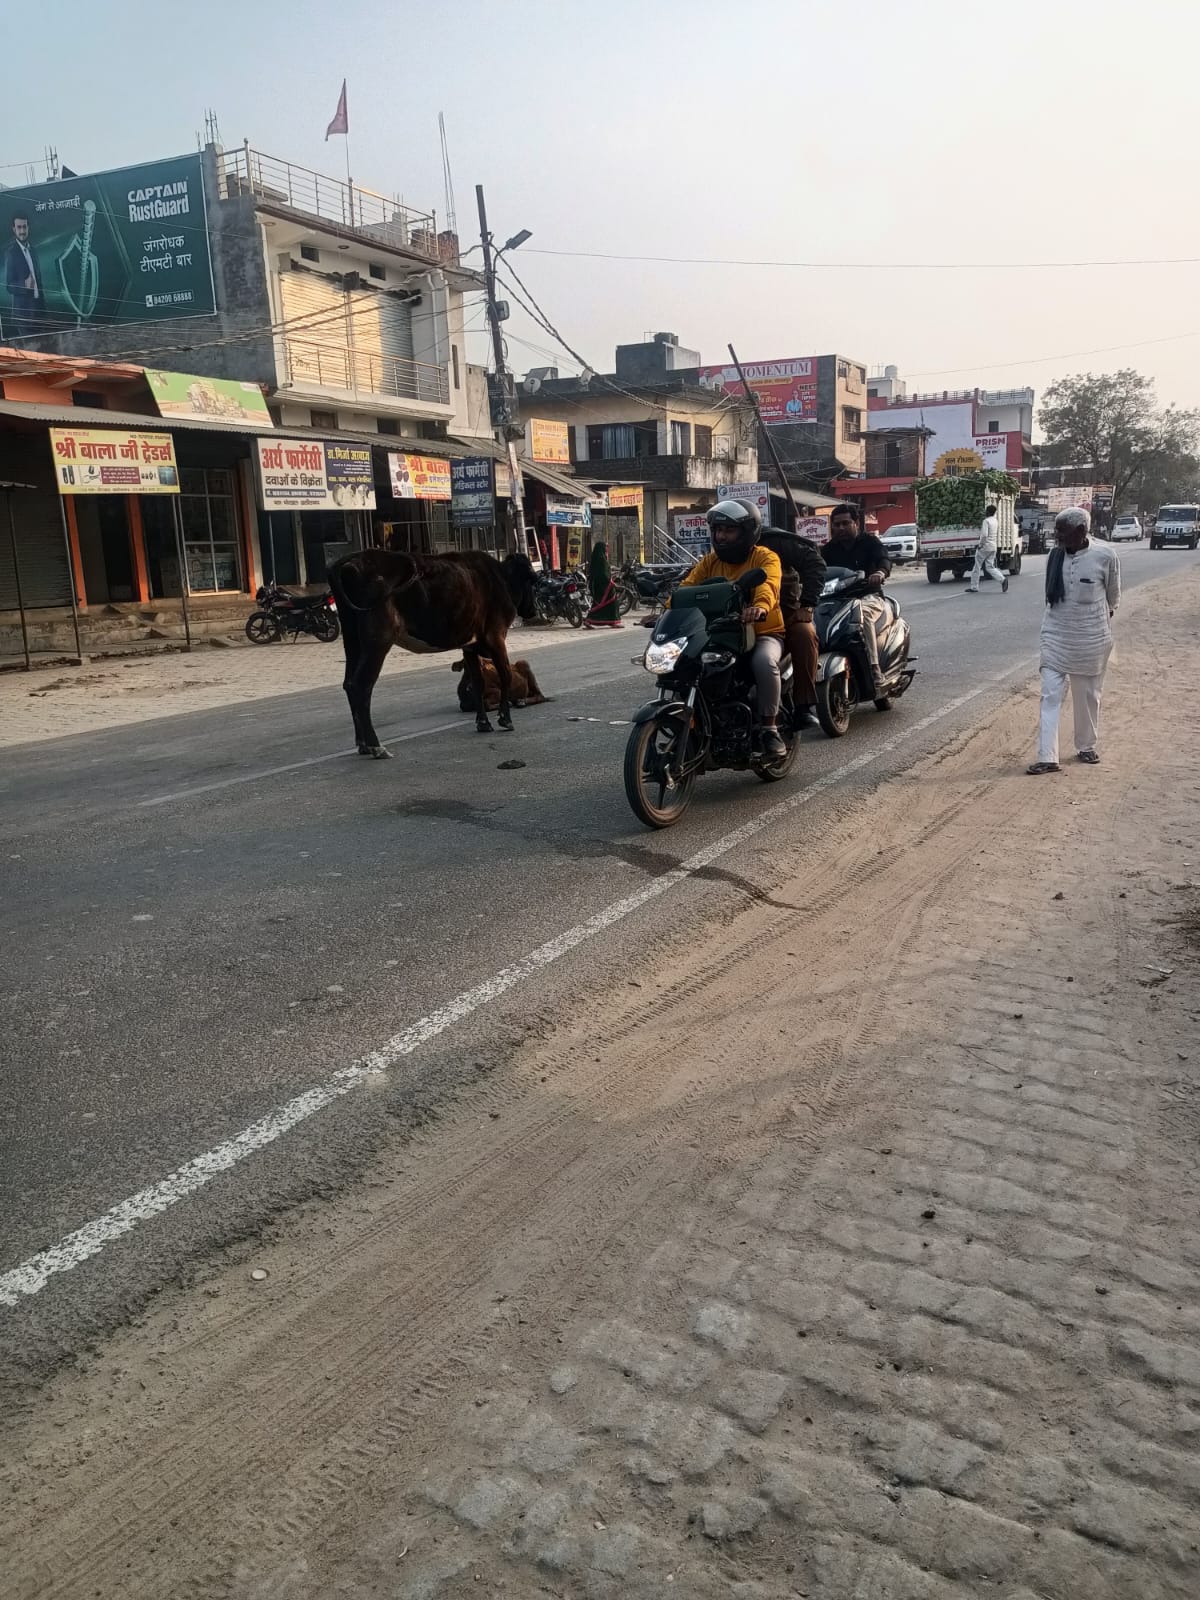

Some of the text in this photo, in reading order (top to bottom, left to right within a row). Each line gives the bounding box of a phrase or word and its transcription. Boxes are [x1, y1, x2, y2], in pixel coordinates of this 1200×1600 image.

[128, 181, 187, 202] CAPTAIN
[129, 194, 189, 222] RustGuard
[143, 234, 184, 252] जंगरोधक
[140, 252, 192, 272] टीएमटी बार
[55, 437, 172, 463] श्री बाला जी ट्रेडर्स
[975, 437, 1005, 446] PRISM
[285, 445, 322, 470] फार्मेसी
[265, 473, 289, 486] दवाओं
[290, 474, 298, 485] के
[299, 473, 323, 487] विक्रेता
